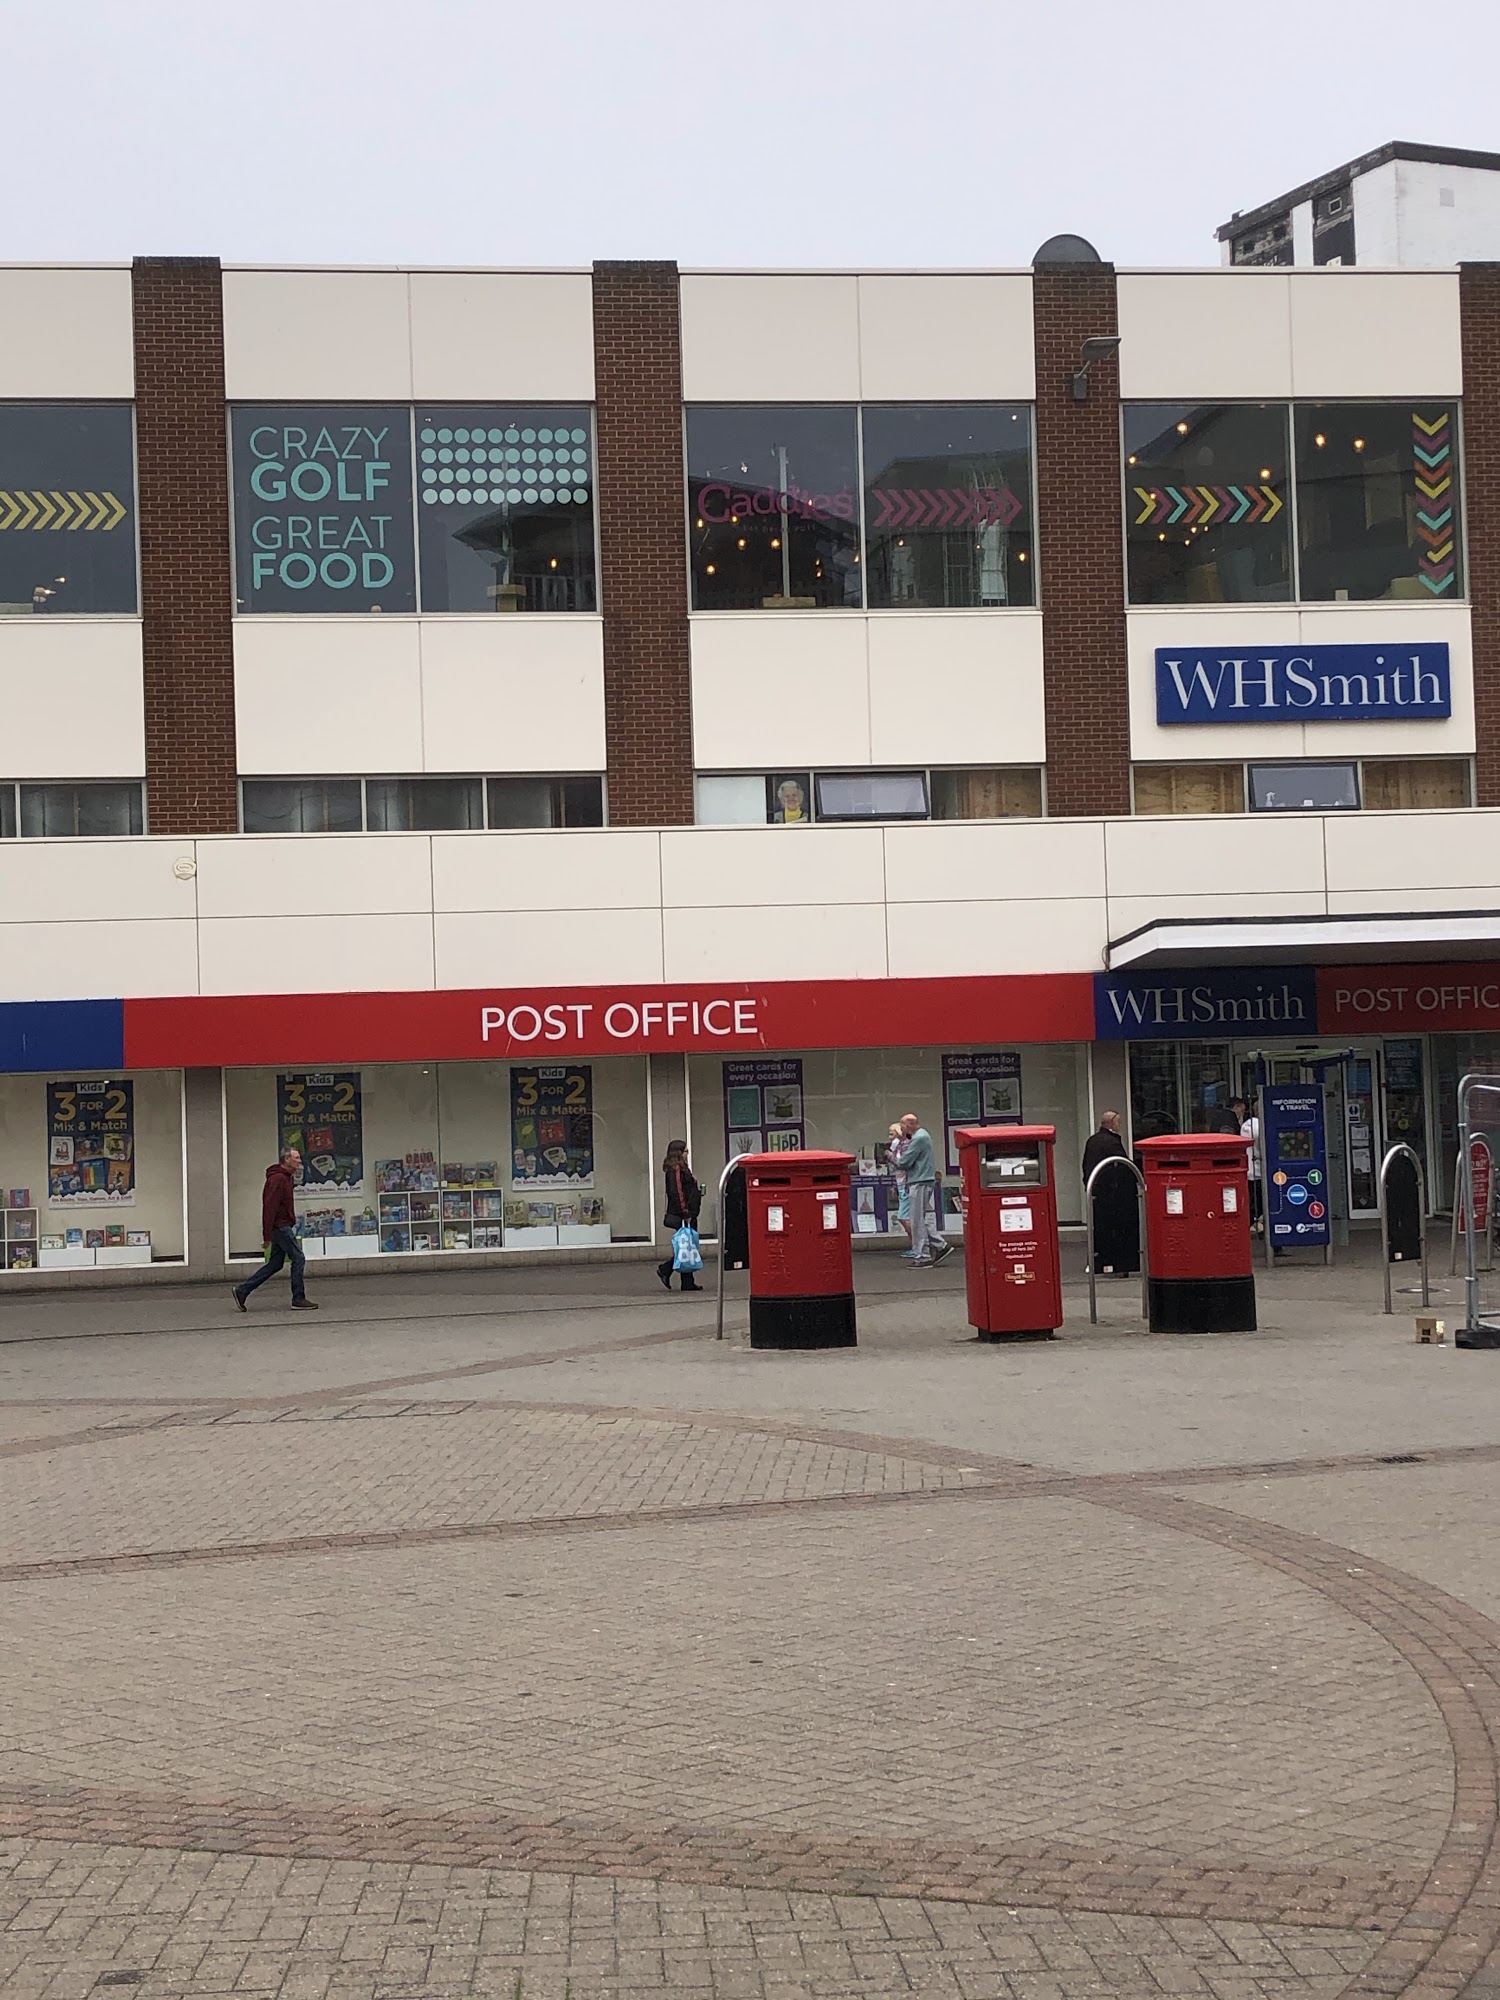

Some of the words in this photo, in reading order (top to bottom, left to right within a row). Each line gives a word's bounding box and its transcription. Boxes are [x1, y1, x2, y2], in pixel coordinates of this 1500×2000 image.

[250, 426, 388, 459] CRAZY
[251, 462, 391, 501] GOLF
[252, 516, 392, 549] GREAT
[253, 552, 394, 590] FOOD
[1164, 655, 1445, 710] WHSmith
[1105, 985, 1306, 1024] WHSmith
[1336, 988, 1408, 1012] POST
[481, 1004, 593, 1042] POST
[604, 1000, 758, 1038] OFFICE
[541, 1069, 563, 1078] Kids
[948, 1057, 972, 1065] Great
[975, 1056, 999, 1064] cards
[976, 1065, 1014, 1074] occasion
[80, 1083, 103, 1092] Kids
[309, 1075, 331, 1084] Kids
[729, 1074, 754, 1082] every
[757, 1071, 796, 1080] occasion
[284, 1084, 306, 1113] 3
[309, 1094, 332, 1103] FOR
[333, 1082, 355, 1112] 2
[518, 1076, 538, 1106] 3
[541, 1086, 564, 1095] FOR
[565, 1076, 586, 1104] 2
[55, 1092, 76, 1120] 3
[80, 1101, 104, 1110] FOR
[105, 1090, 127, 1119] 2
[284, 1114, 304, 1124] Mix
[308, 1114, 316, 1123] &
[320, 1112, 355, 1122] Match
[516, 1106, 536, 1116] Mix
[540, 1106, 548, 1116] &
[552, 1105, 587, 1115] Match
[54, 1122, 74, 1132] Mix
[78, 1122, 87, 1131] &
[90, 1121, 127, 1130] Match
